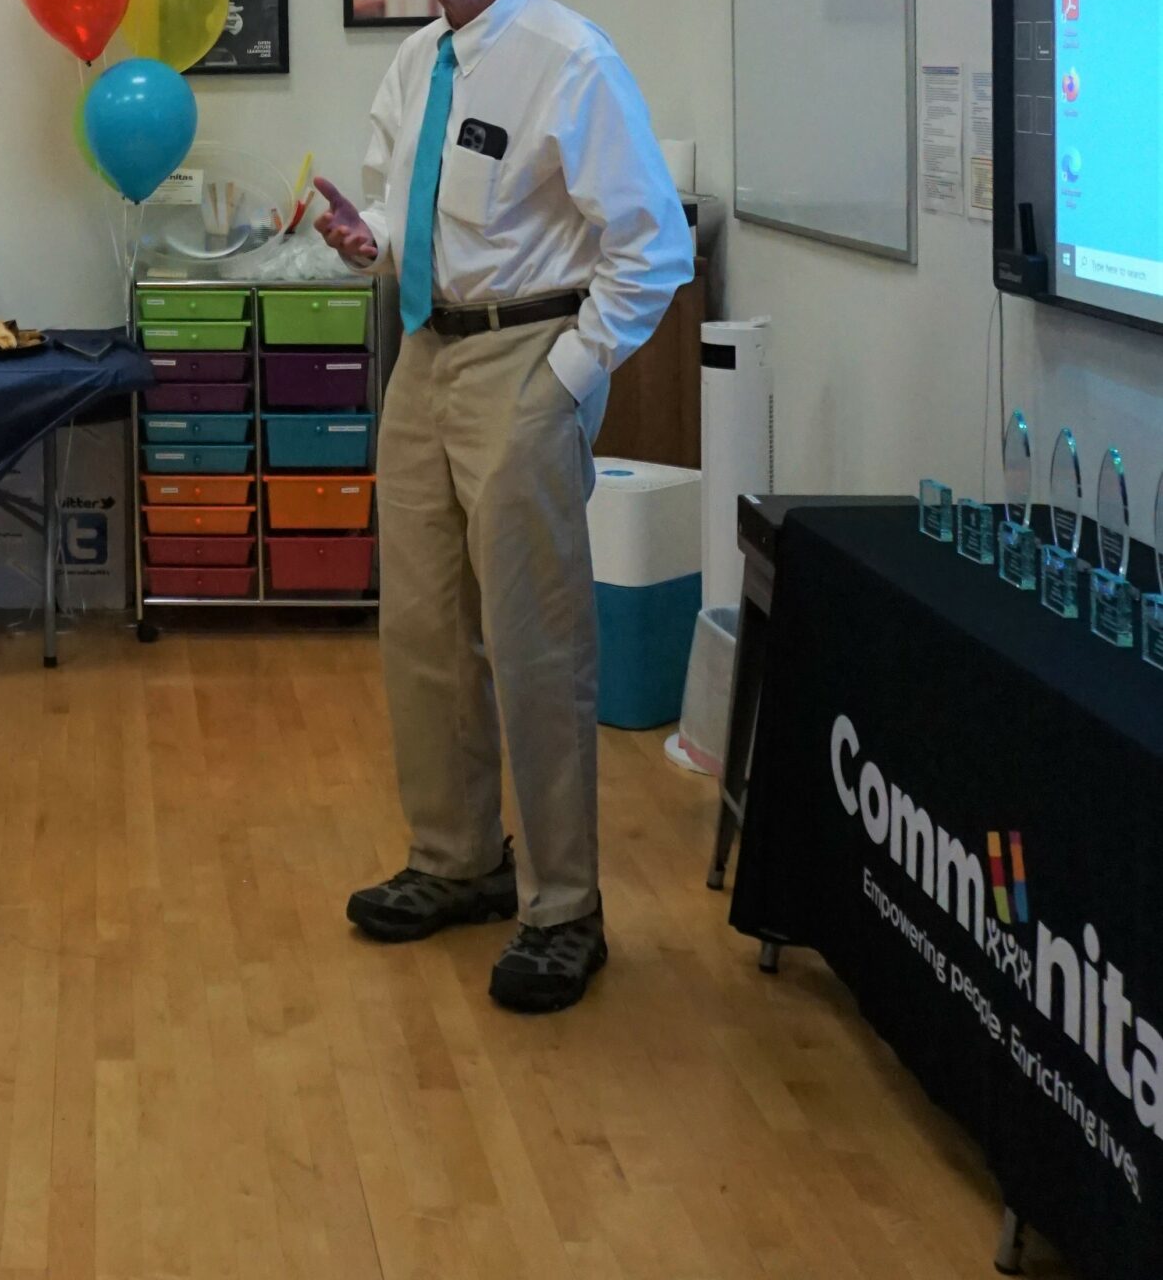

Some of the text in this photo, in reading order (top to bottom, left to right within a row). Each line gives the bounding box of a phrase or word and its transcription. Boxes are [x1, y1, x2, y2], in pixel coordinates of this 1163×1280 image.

[169, 173, 193, 181] nitas
[863, 867, 946, 984] Empowering
[951, 963, 1006, 1046] people.
[1010, 1024, 1096, 1149] Enriching
